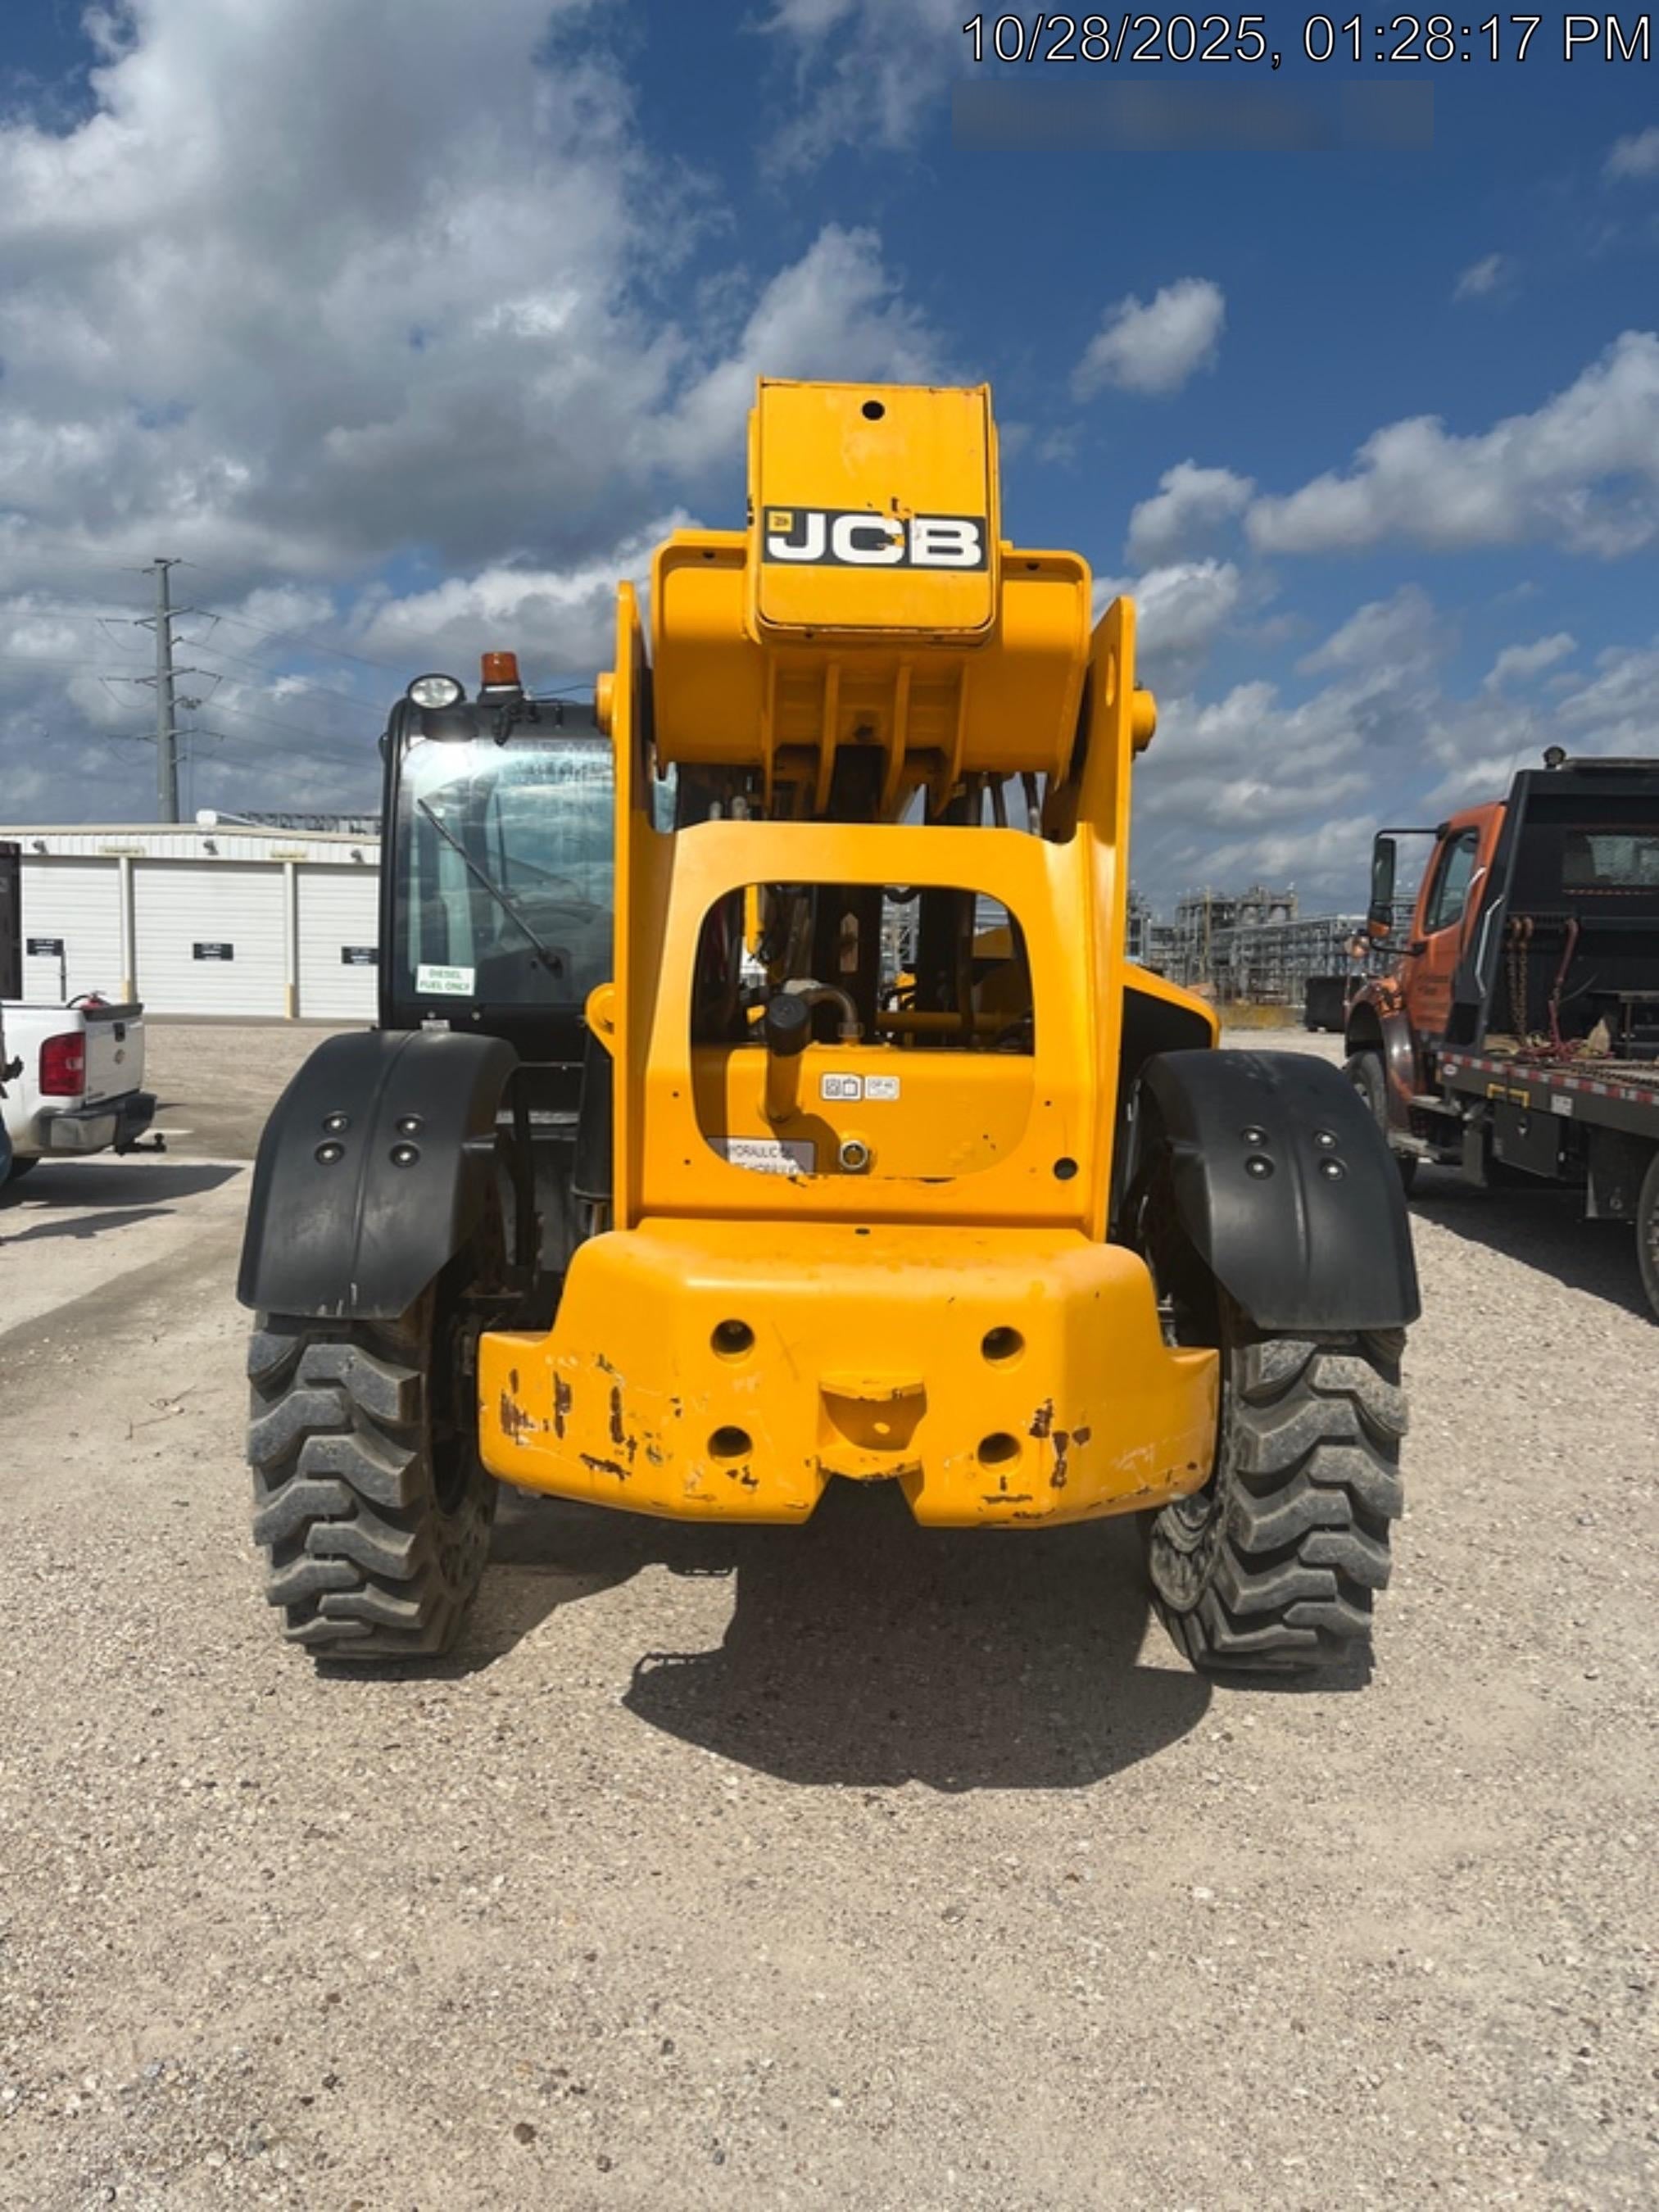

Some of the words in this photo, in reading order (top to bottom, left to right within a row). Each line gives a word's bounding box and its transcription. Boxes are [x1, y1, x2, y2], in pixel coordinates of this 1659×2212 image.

[768, 513, 981, 566] JCB
[429, 969, 461, 980] DIESEL
[419, 980, 443, 990] FUEL
[445, 981, 470, 991] ONLY
